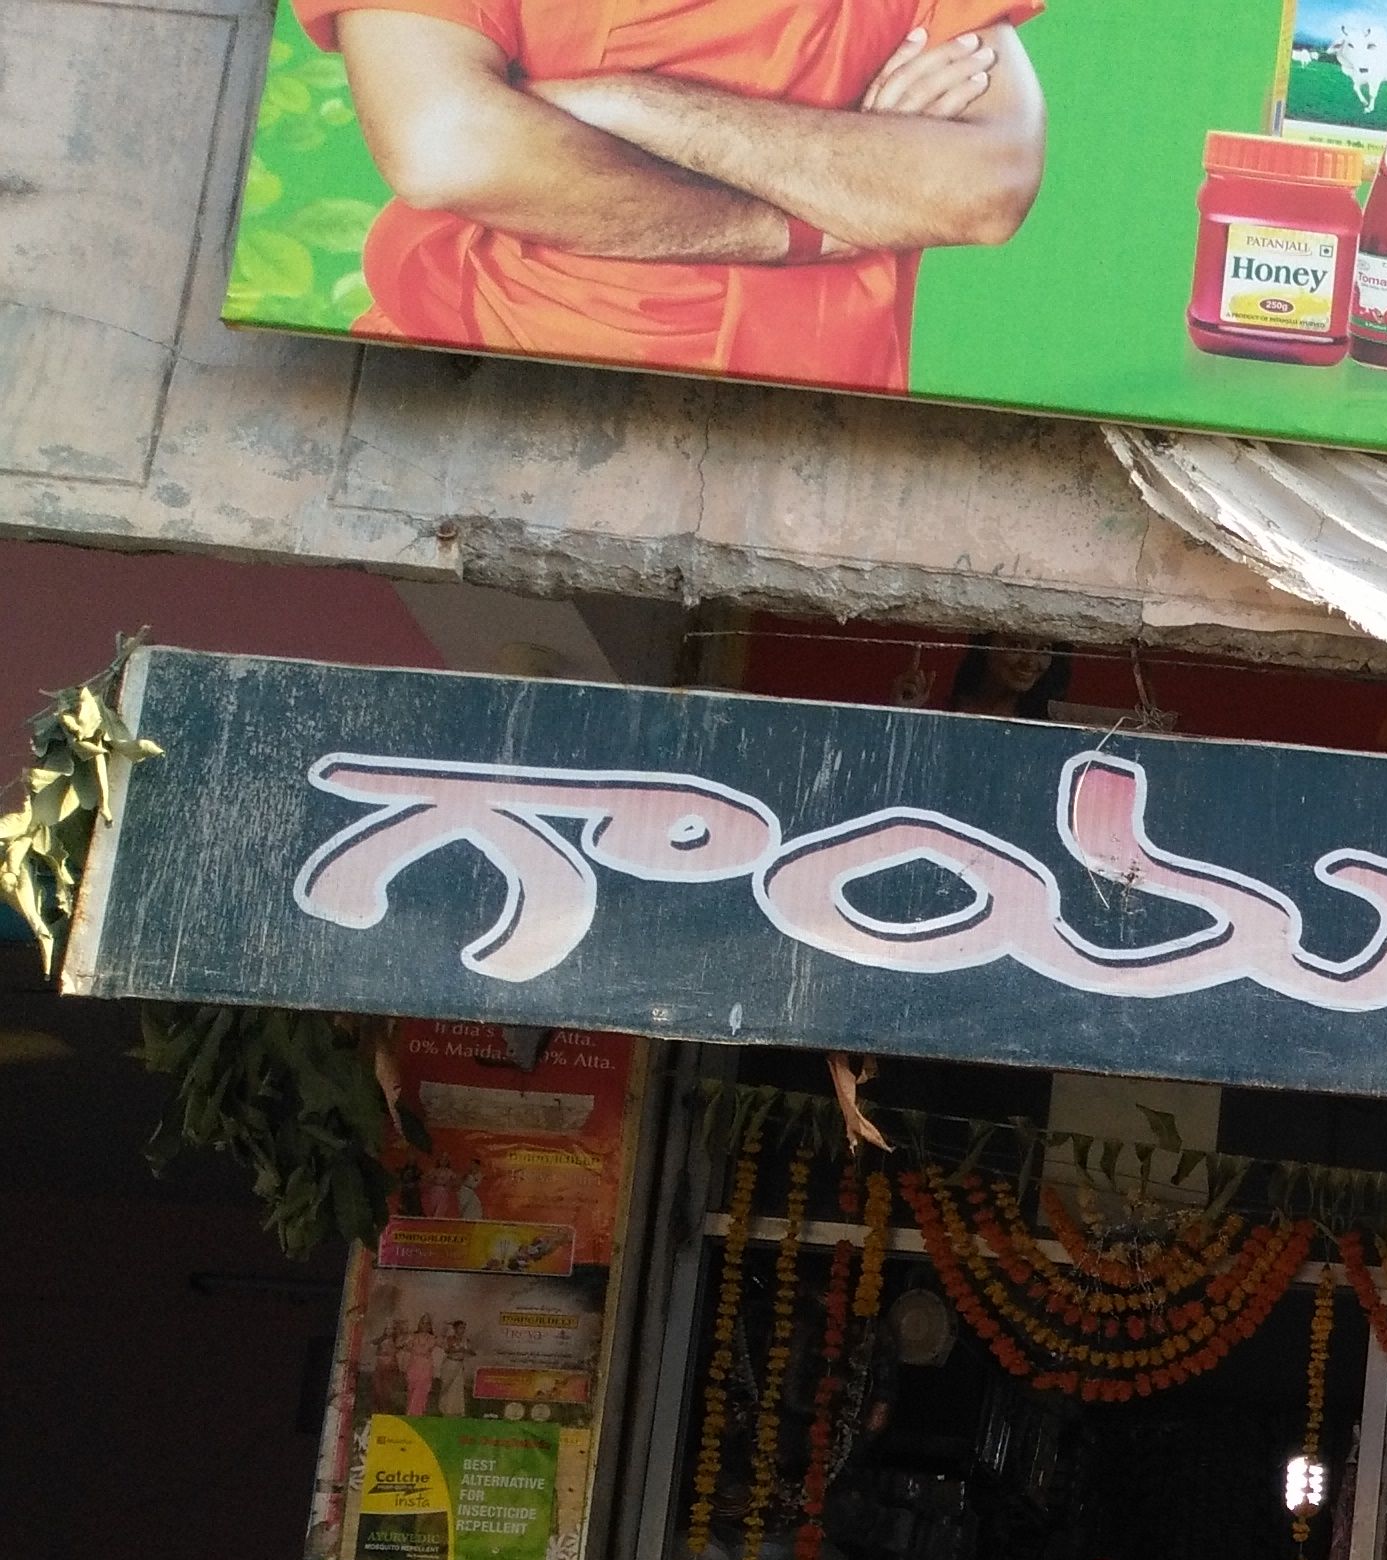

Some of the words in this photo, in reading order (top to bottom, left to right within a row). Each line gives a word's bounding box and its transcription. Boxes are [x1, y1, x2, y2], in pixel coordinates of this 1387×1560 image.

[1246, 235, 1309, 253] PATANJALI
[1231, 255, 1329, 294] Honey
[1265, 300, 1290, 312] 250g
[409, 1038, 439, 1054] 0%
[574, 1053, 616, 1070] Atta.
[462, 1457, 497, 1472] BEST
[375, 1470, 431, 1484] Catche
[461, 1473, 545, 1491] ALTERNATIVE
[458, 1488, 486, 1502] FOR
[457, 1503, 537, 1521] INSECTICIDE
[456, 1518, 528, 1535] REPELLENT
[367, 1529, 440, 1545] AYURVEDIC
